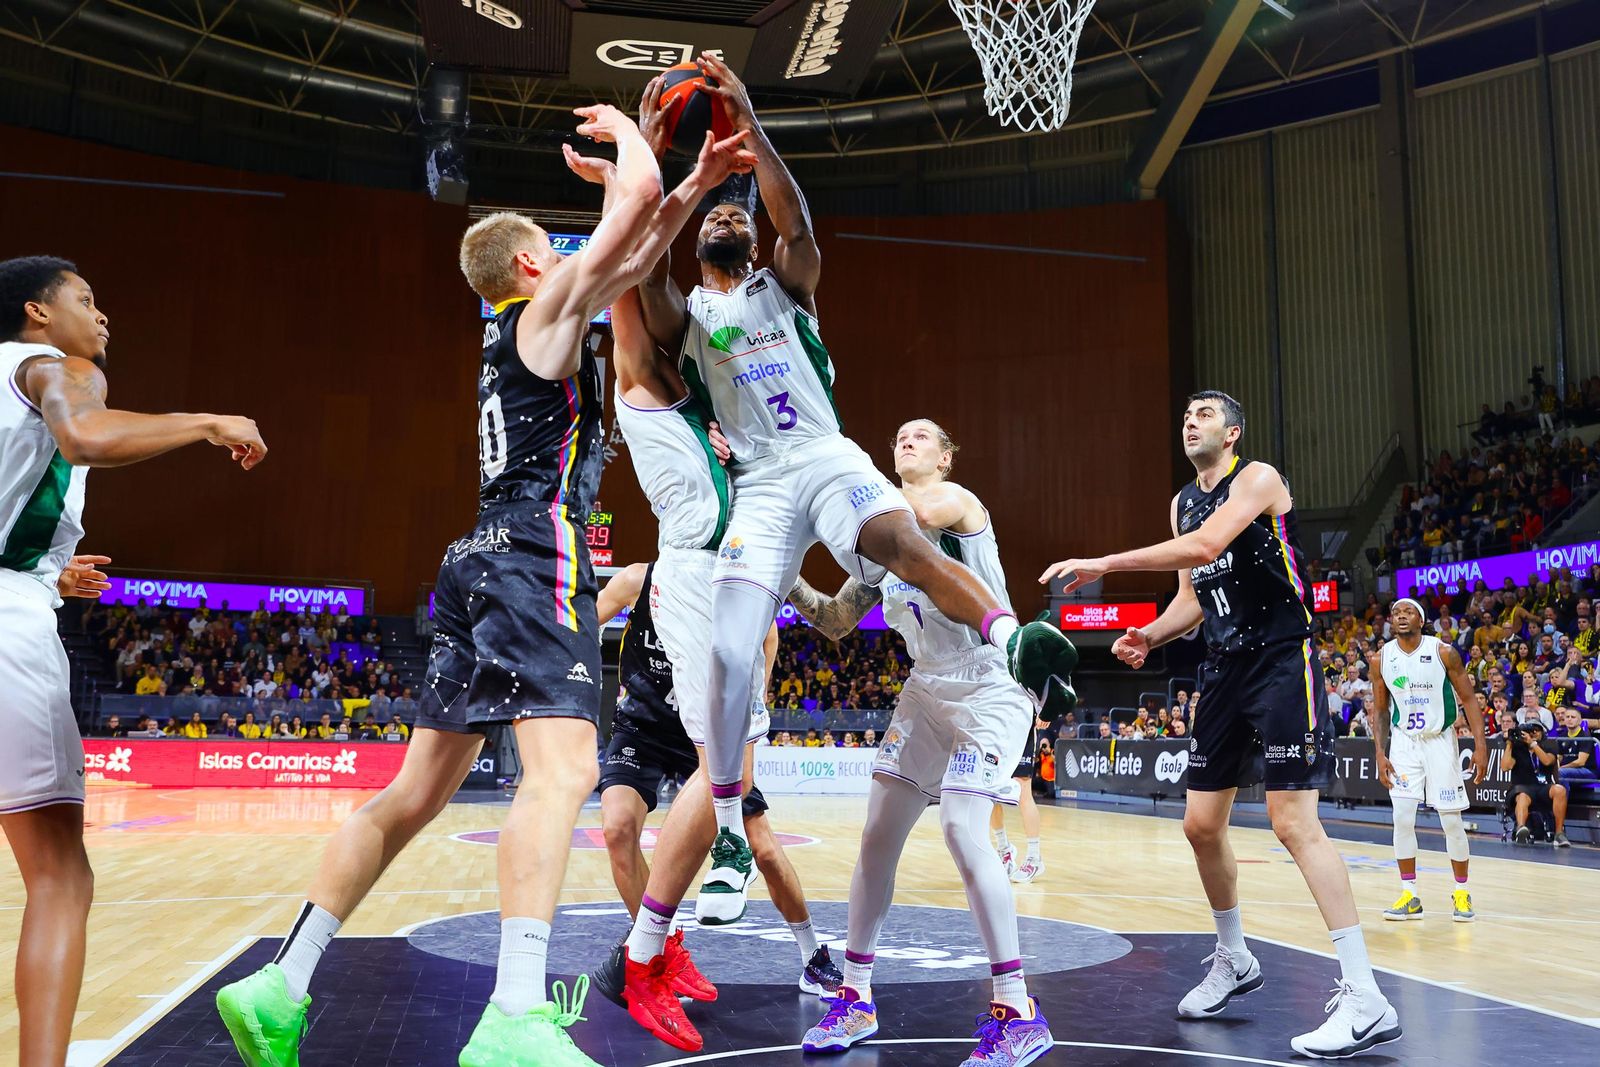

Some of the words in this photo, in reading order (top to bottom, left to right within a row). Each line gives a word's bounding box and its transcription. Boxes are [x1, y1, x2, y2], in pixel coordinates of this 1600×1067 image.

[553, 238, 570, 249] 27
[579, 239, 588, 250] 3
[766, 391, 797, 431] 3
[477, 391, 508, 480] 0
[586, 526, 609, 546] 3.9
[494, 544, 511, 553] Car
[1415, 562, 1483, 587] HOVIMA
[124, 580, 208, 599] HOVIMA
[269, 588, 349, 606] HOVIMA
[1065, 613, 1103, 622] Canarias
[1083, 607, 1103, 615] Islas
[1406, 712, 1426, 730] 55
[1268, 745, 1286, 753] Islas
[199, 751, 244, 769] Islas
[246, 751, 332, 770] Canarias
[757, 760, 798, 776] BOTELLA
[799, 760, 835, 777] 100%
[1080, 750, 1143, 779] cajaiete
[1160, 758, 1183, 773] isola
